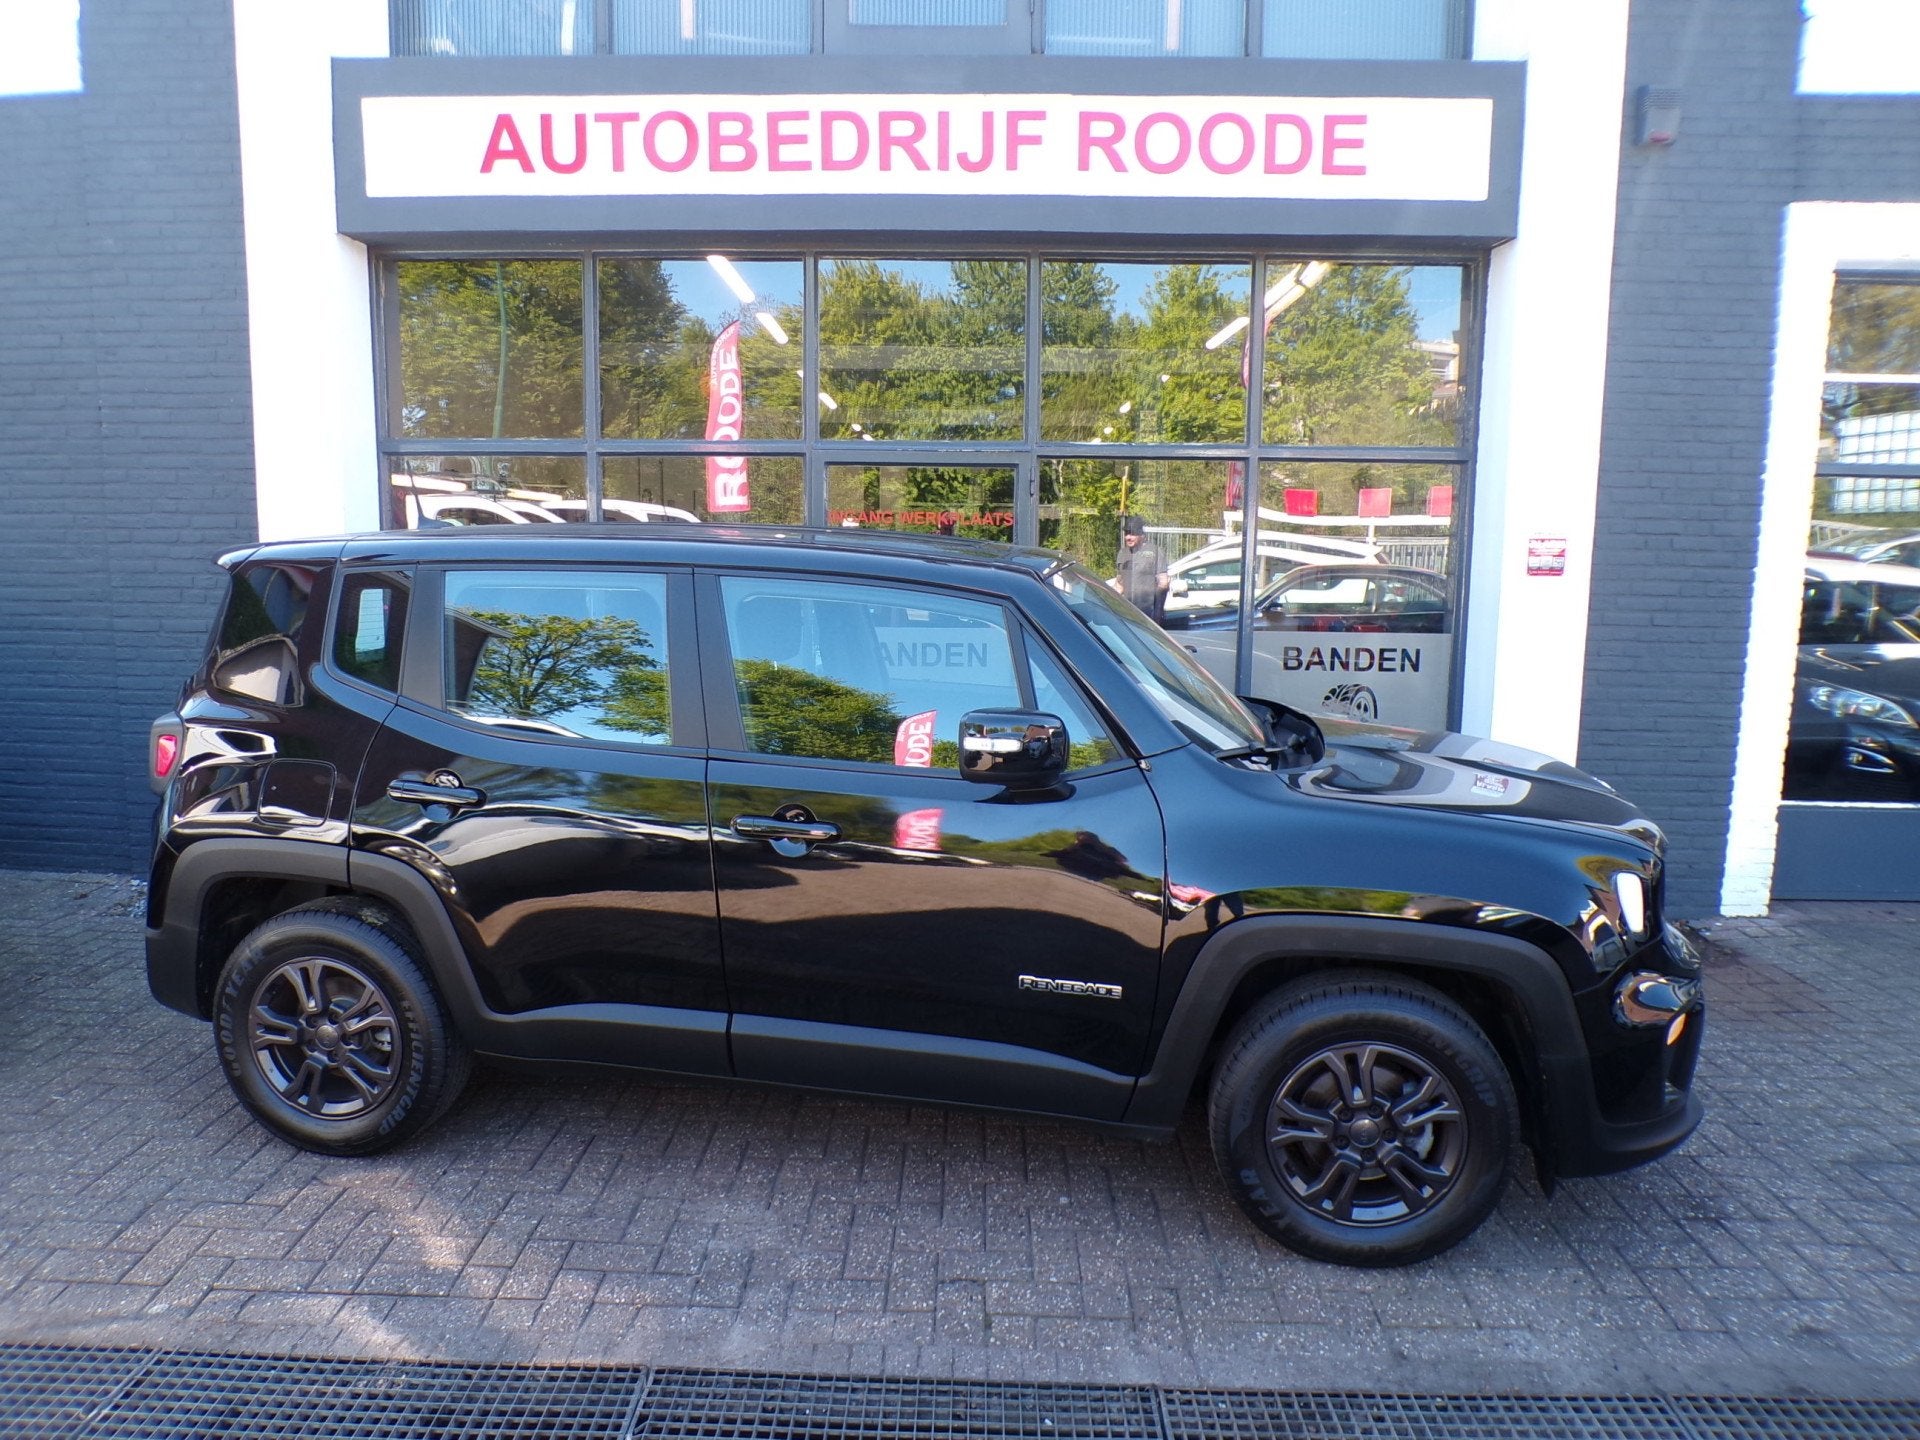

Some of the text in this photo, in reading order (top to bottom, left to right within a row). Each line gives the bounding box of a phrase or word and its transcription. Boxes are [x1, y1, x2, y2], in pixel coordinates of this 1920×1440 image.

[480, 109, 1368, 176] AUTOBEDRIJF ROODE
[713, 345, 748, 506] ROODE
[899, 510, 1015, 527] WERKPLAATS
[874, 641, 988, 668] ANDEN
[1283, 646, 1421, 673] BANDEN
[1018, 974, 1123, 999] RENEGADE
[219, 949, 265, 1077] GOODYEAR
